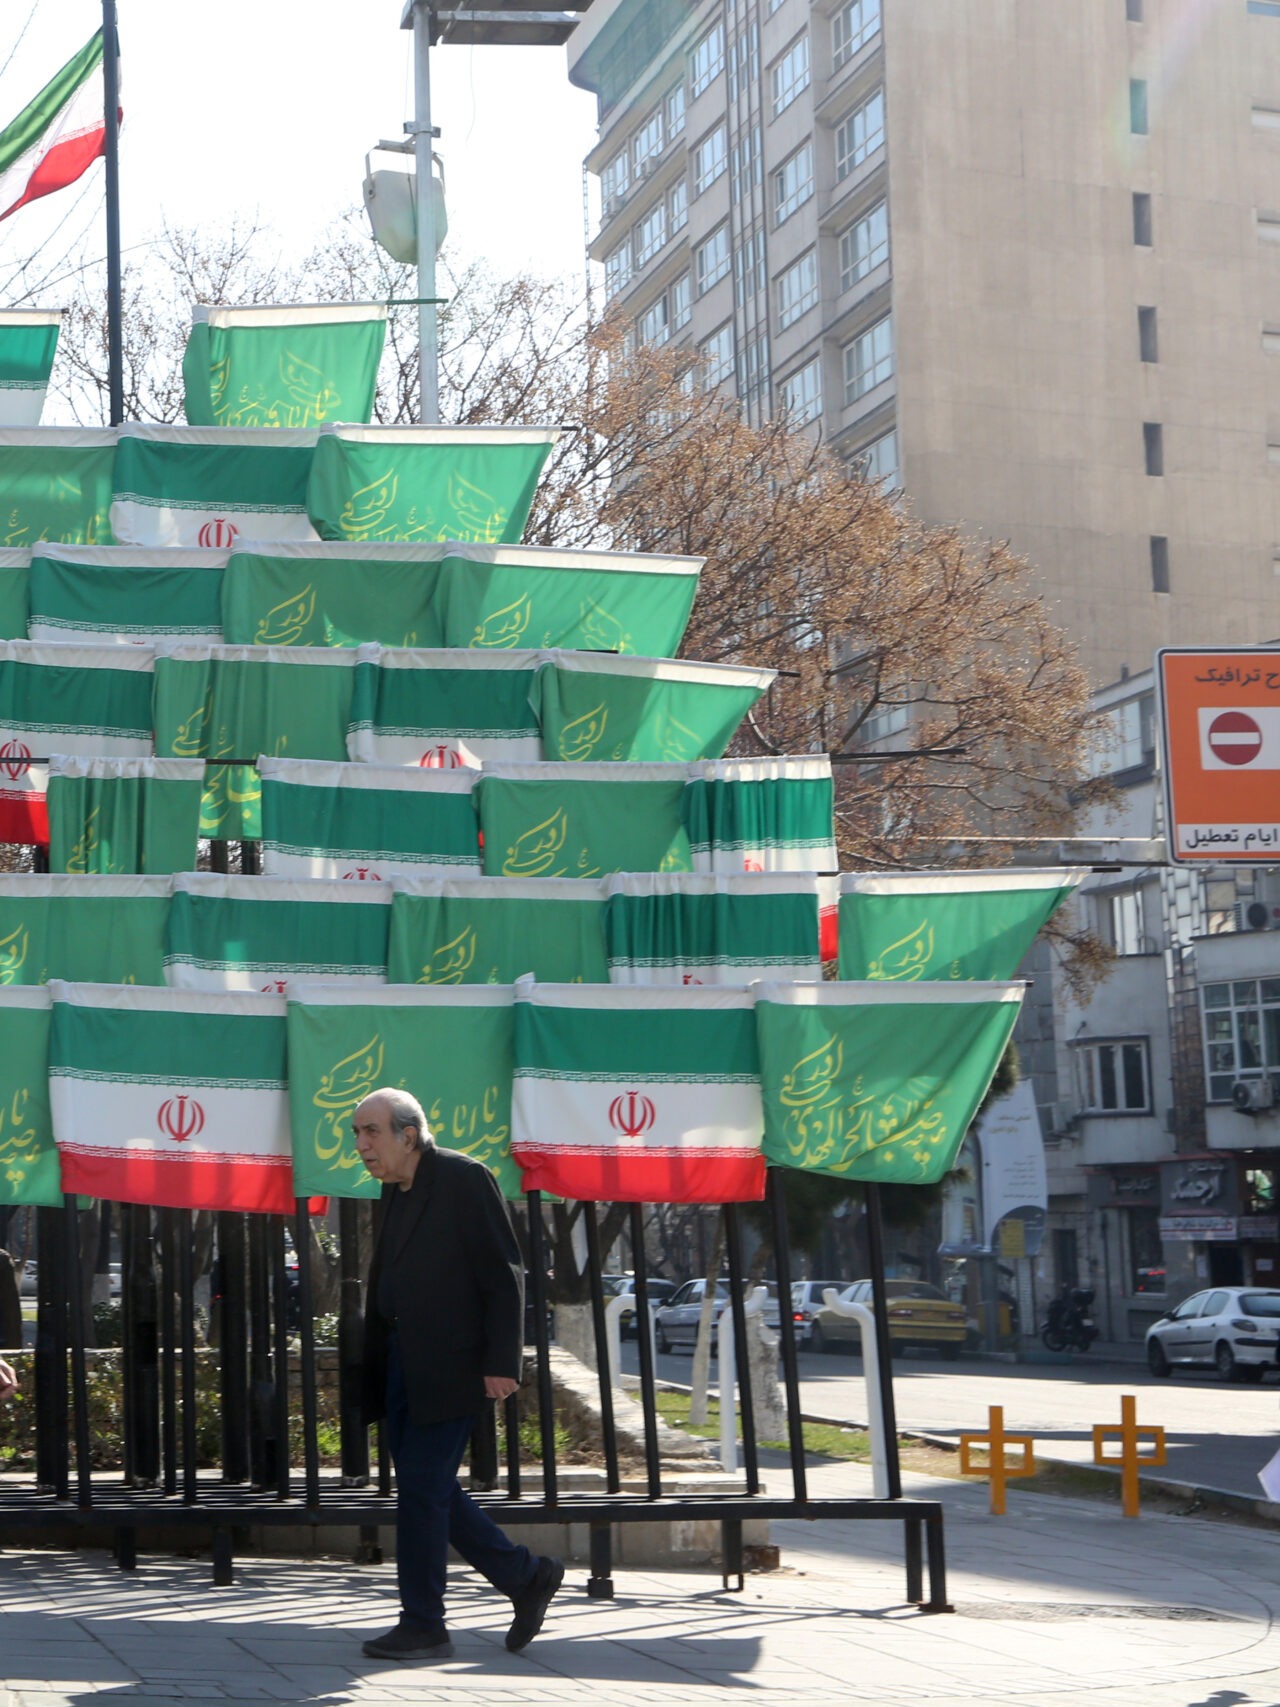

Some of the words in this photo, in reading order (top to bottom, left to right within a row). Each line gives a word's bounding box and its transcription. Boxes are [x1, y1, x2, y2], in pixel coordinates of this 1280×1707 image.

[1194, 667, 1261, 687] ترافیک
[1186, 828, 1239, 849] تعطیل
[1244, 828, 1278, 850] ایام
